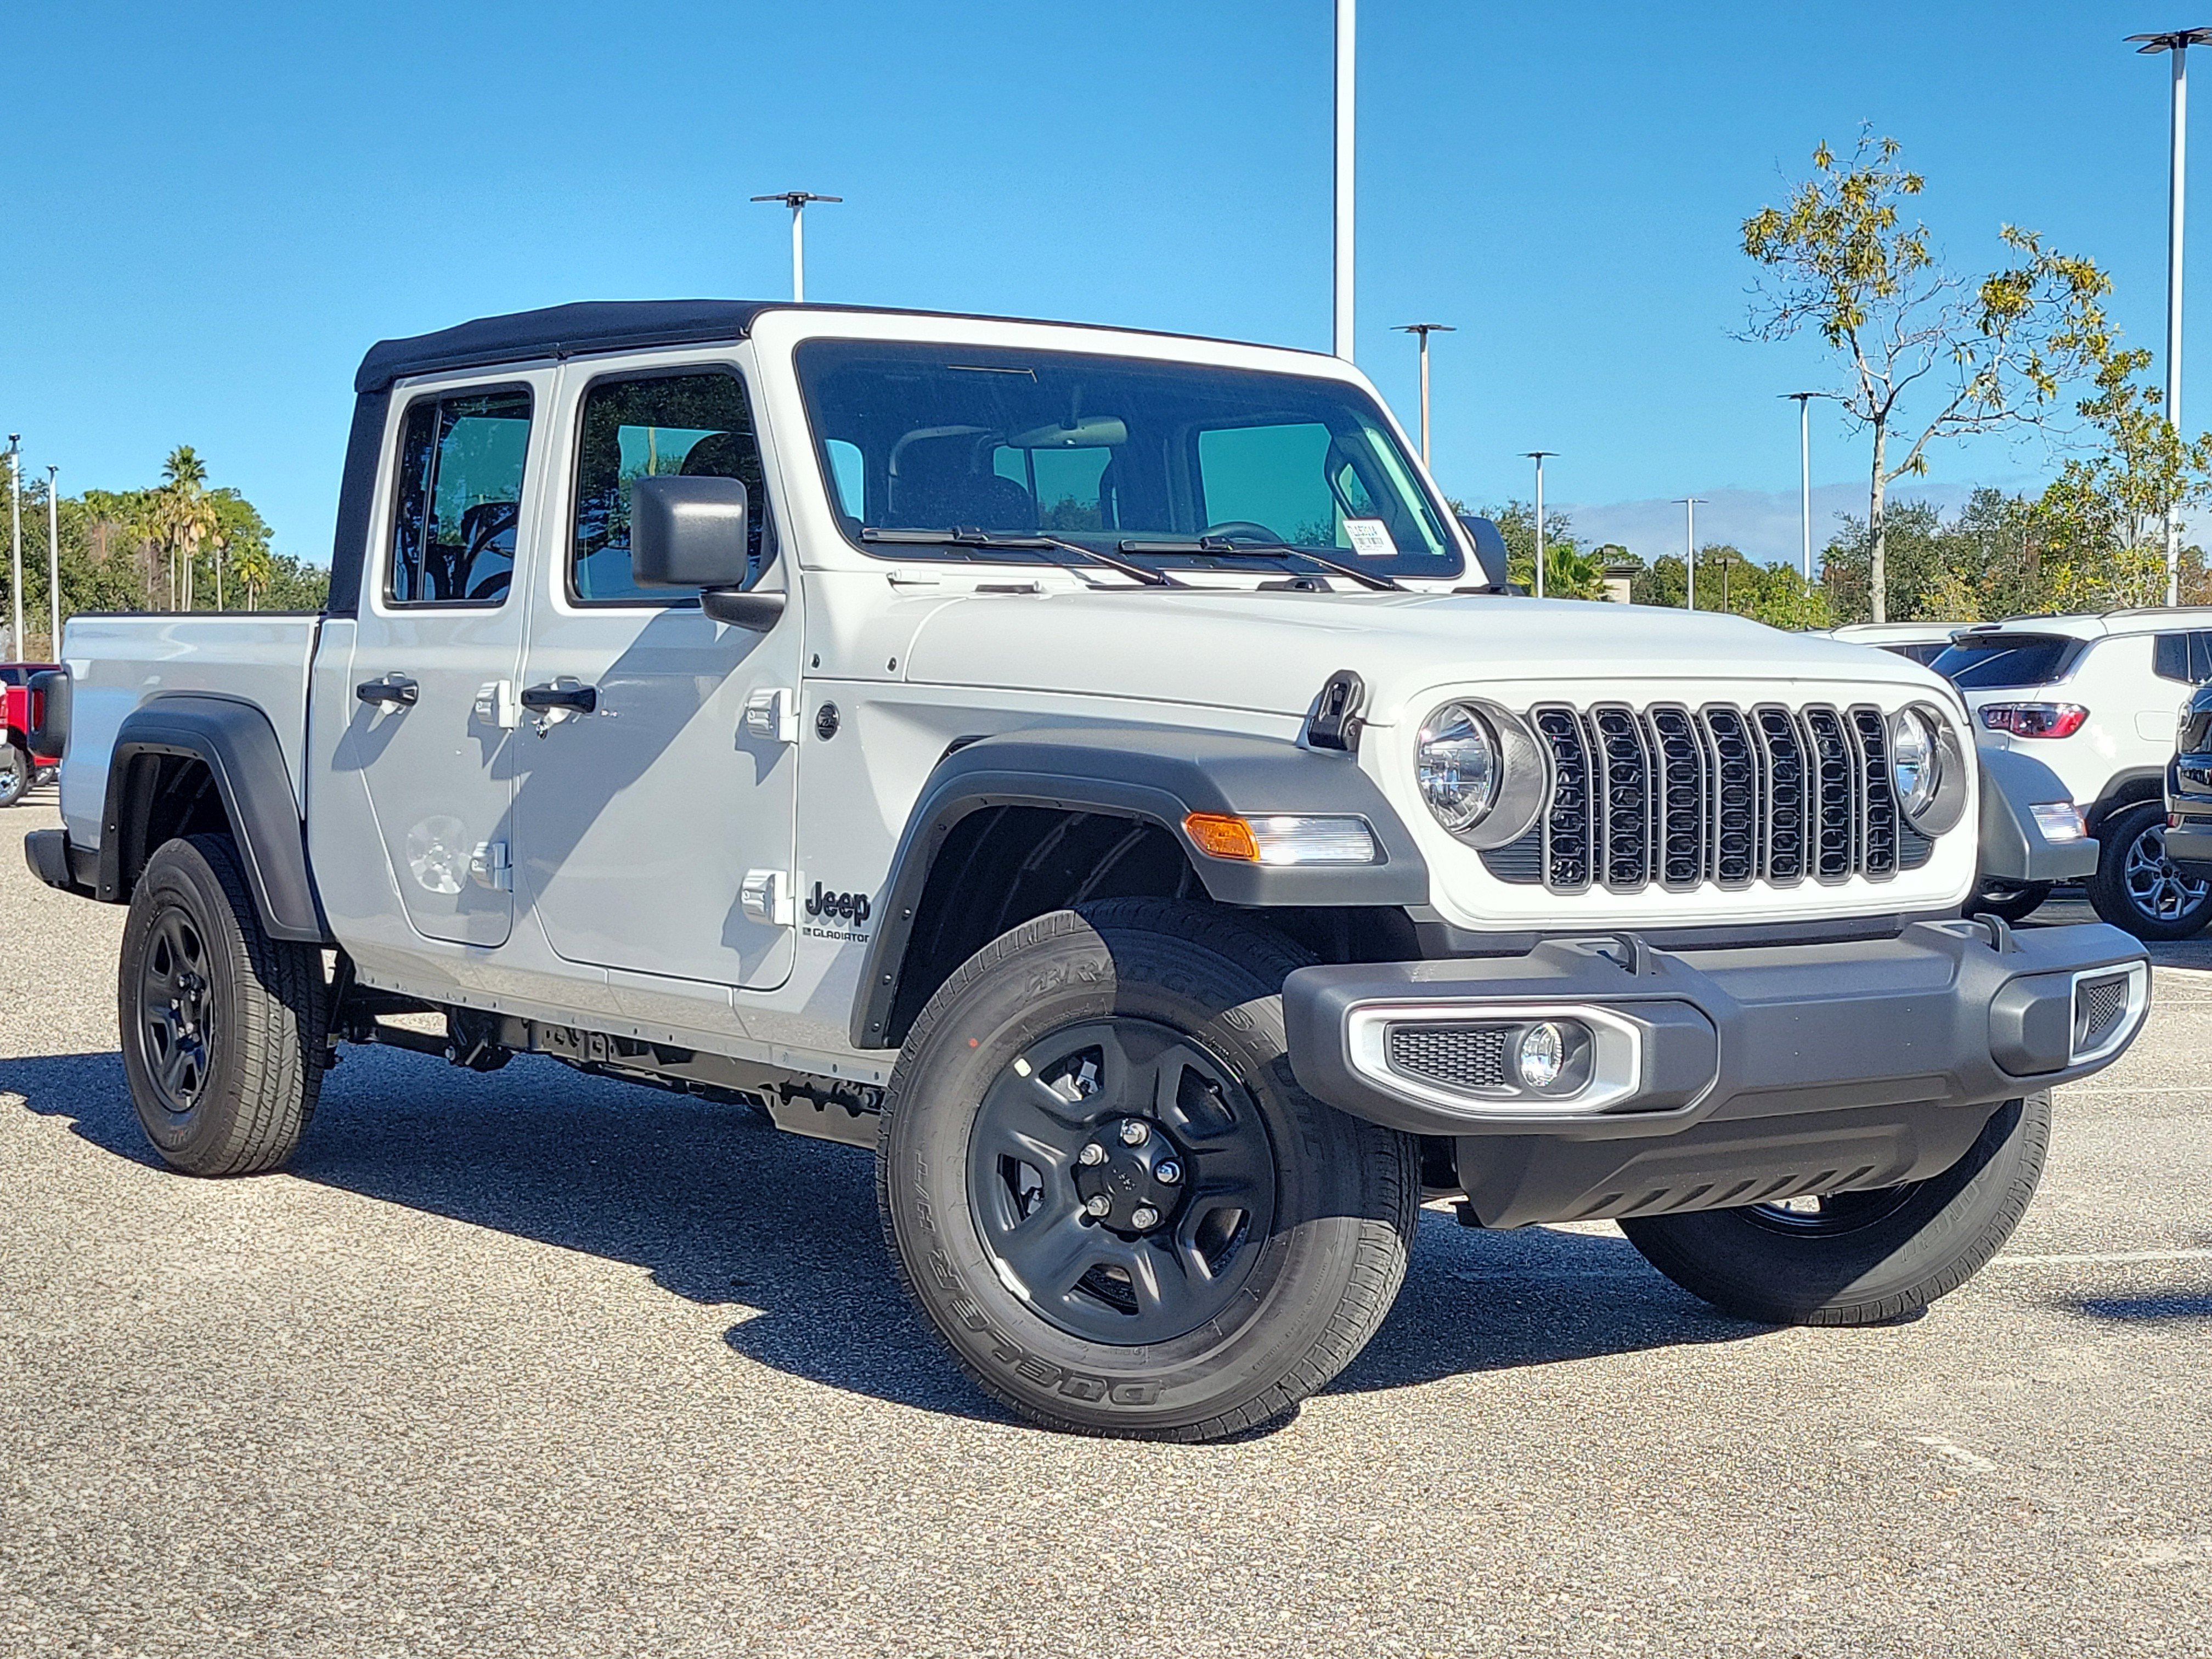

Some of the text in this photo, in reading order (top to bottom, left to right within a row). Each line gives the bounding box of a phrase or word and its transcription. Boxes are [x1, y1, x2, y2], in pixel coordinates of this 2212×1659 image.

[805, 881, 871, 927] Jeep
[813, 928, 870, 943] GLADIATOR
[914, 1152, 1164, 1406] DUELER H/T
